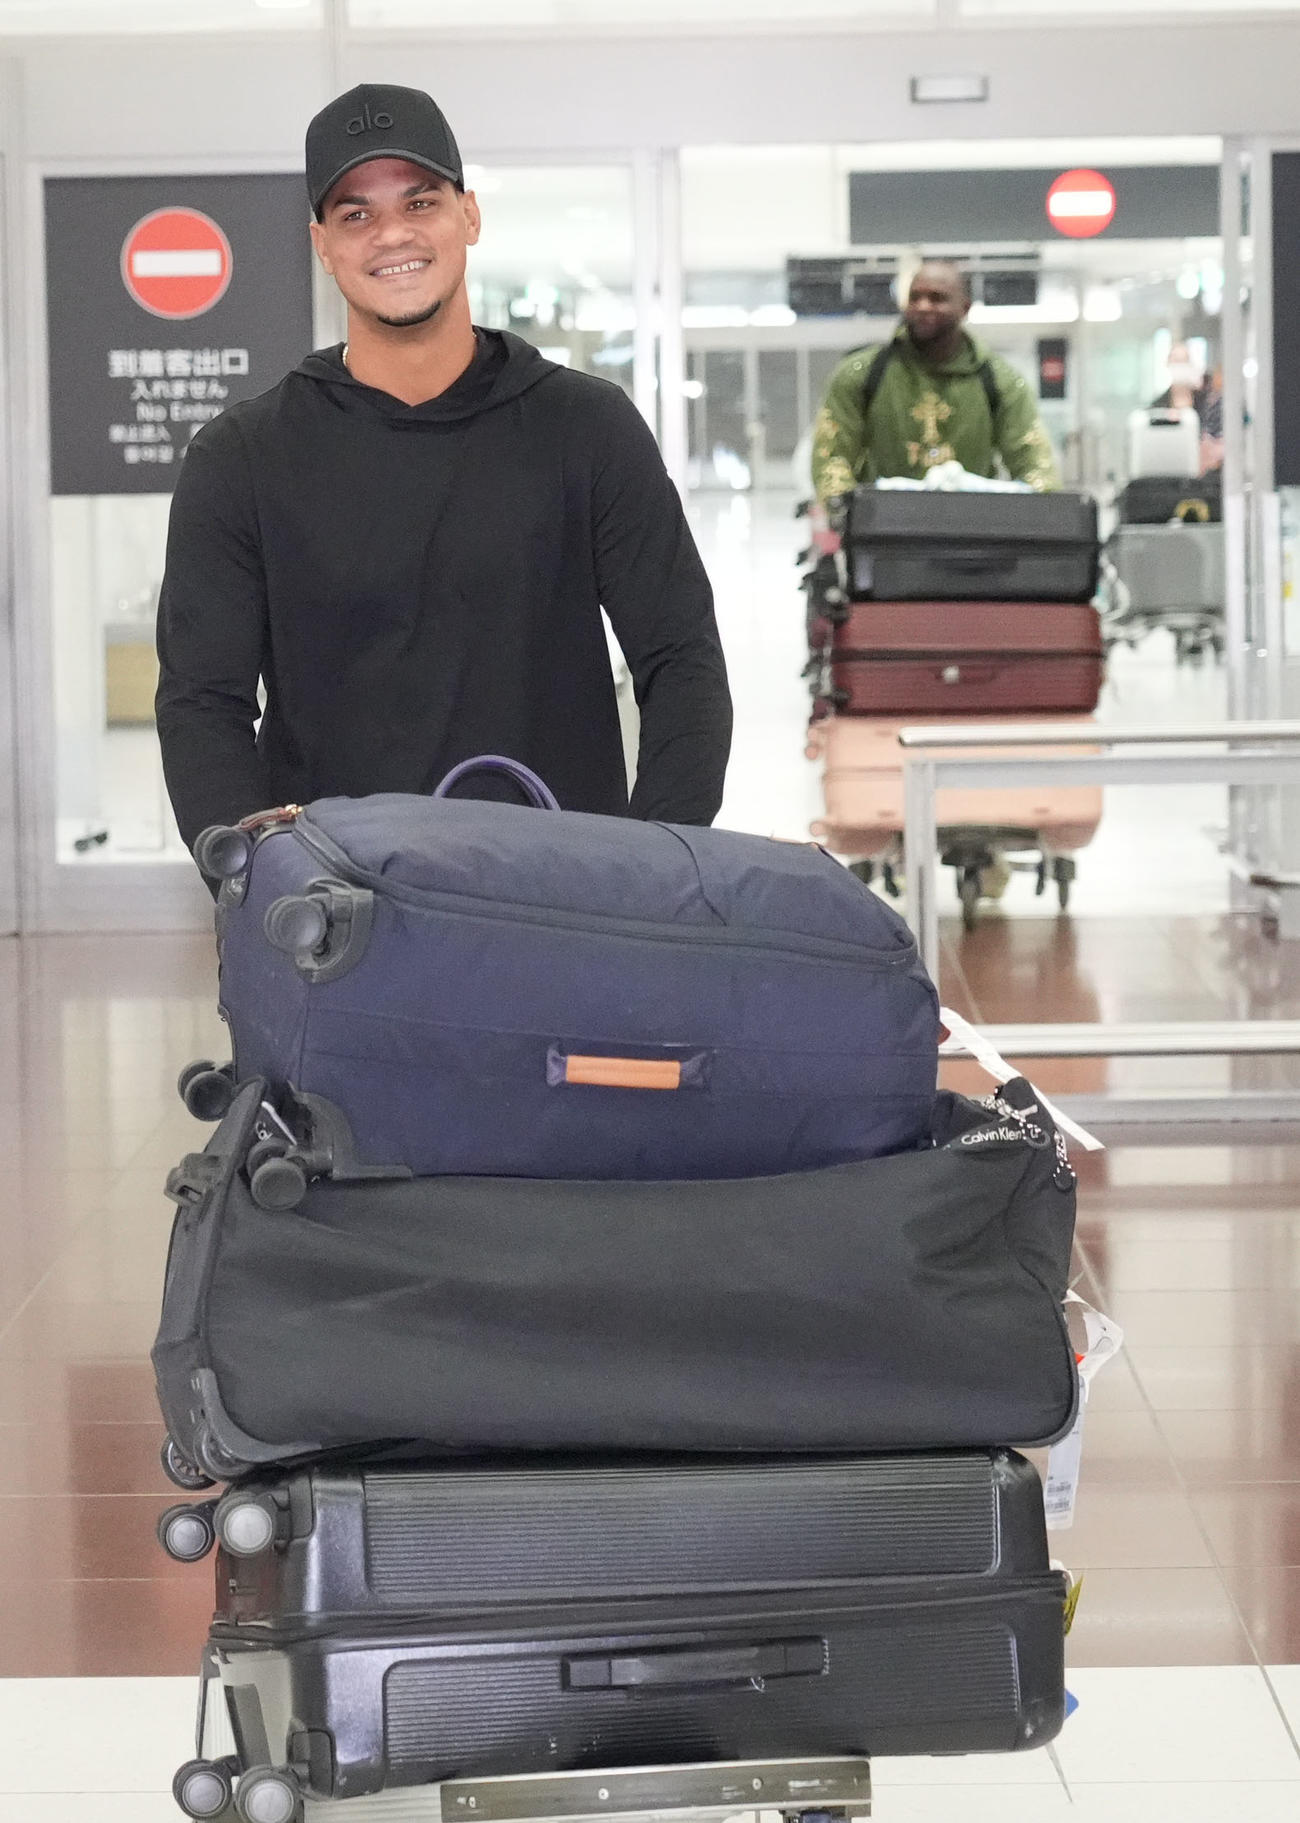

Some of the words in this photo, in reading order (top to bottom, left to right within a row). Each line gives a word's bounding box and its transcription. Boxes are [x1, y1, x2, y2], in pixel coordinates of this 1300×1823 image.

[346, 104, 394, 136] alo
[961, 1128, 1000, 1145] Calvin
[1000, 1127, 1022, 1141] Klein
